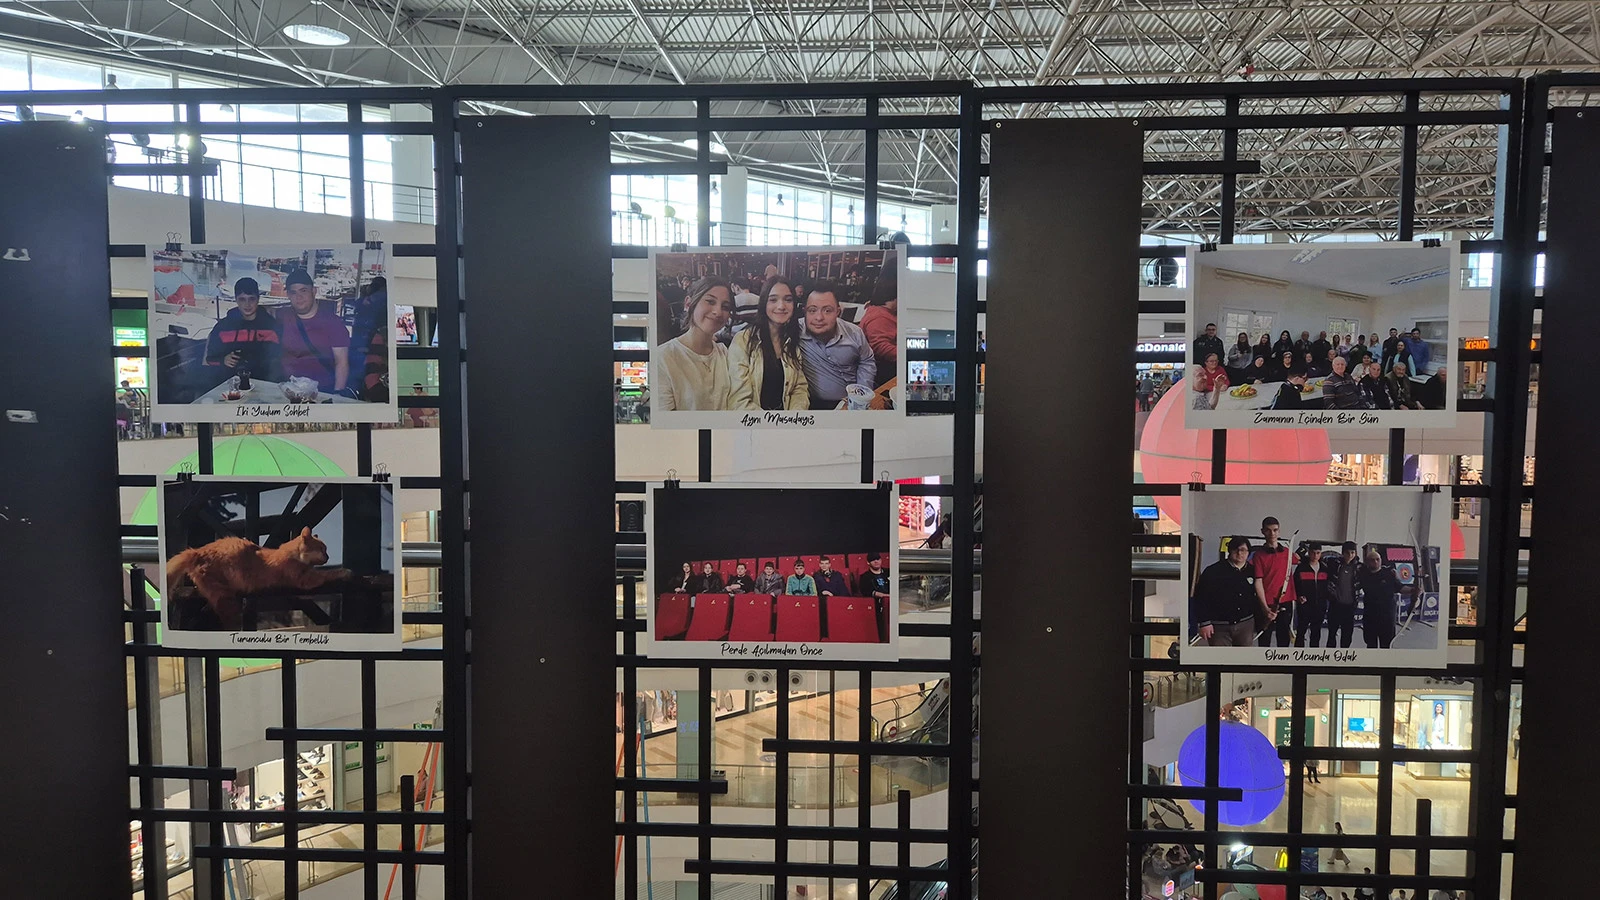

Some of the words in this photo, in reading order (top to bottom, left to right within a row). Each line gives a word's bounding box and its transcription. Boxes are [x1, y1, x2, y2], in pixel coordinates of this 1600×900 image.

[906, 338, 926, 349] KING
[1136, 343, 1186, 352] cDonald
[236, 405, 249, 417] İki
[251, 405, 281, 417] Yudum
[283, 404, 310, 417] Sohbet
[1253, 411, 1294, 425] Zamanın
[1298, 410, 1333, 425] İçinden
[1337, 411, 1355, 425] Bir
[1359, 411, 1379, 425] Gün
[740, 413, 762, 427] Aynı
[764, 411, 815, 427] Masadayız
[229, 632, 272, 644] Turunculu
[274, 633, 290, 644] Bir
[292, 632, 330, 646] Tembellik
[720, 642, 748, 656] Perde
[751, 643, 797, 658] Açılmadan
[1264, 648, 1290, 662] Okun
[1292, 649, 1331, 662] Ucunda
[1333, 649, 1358, 663] Odak
